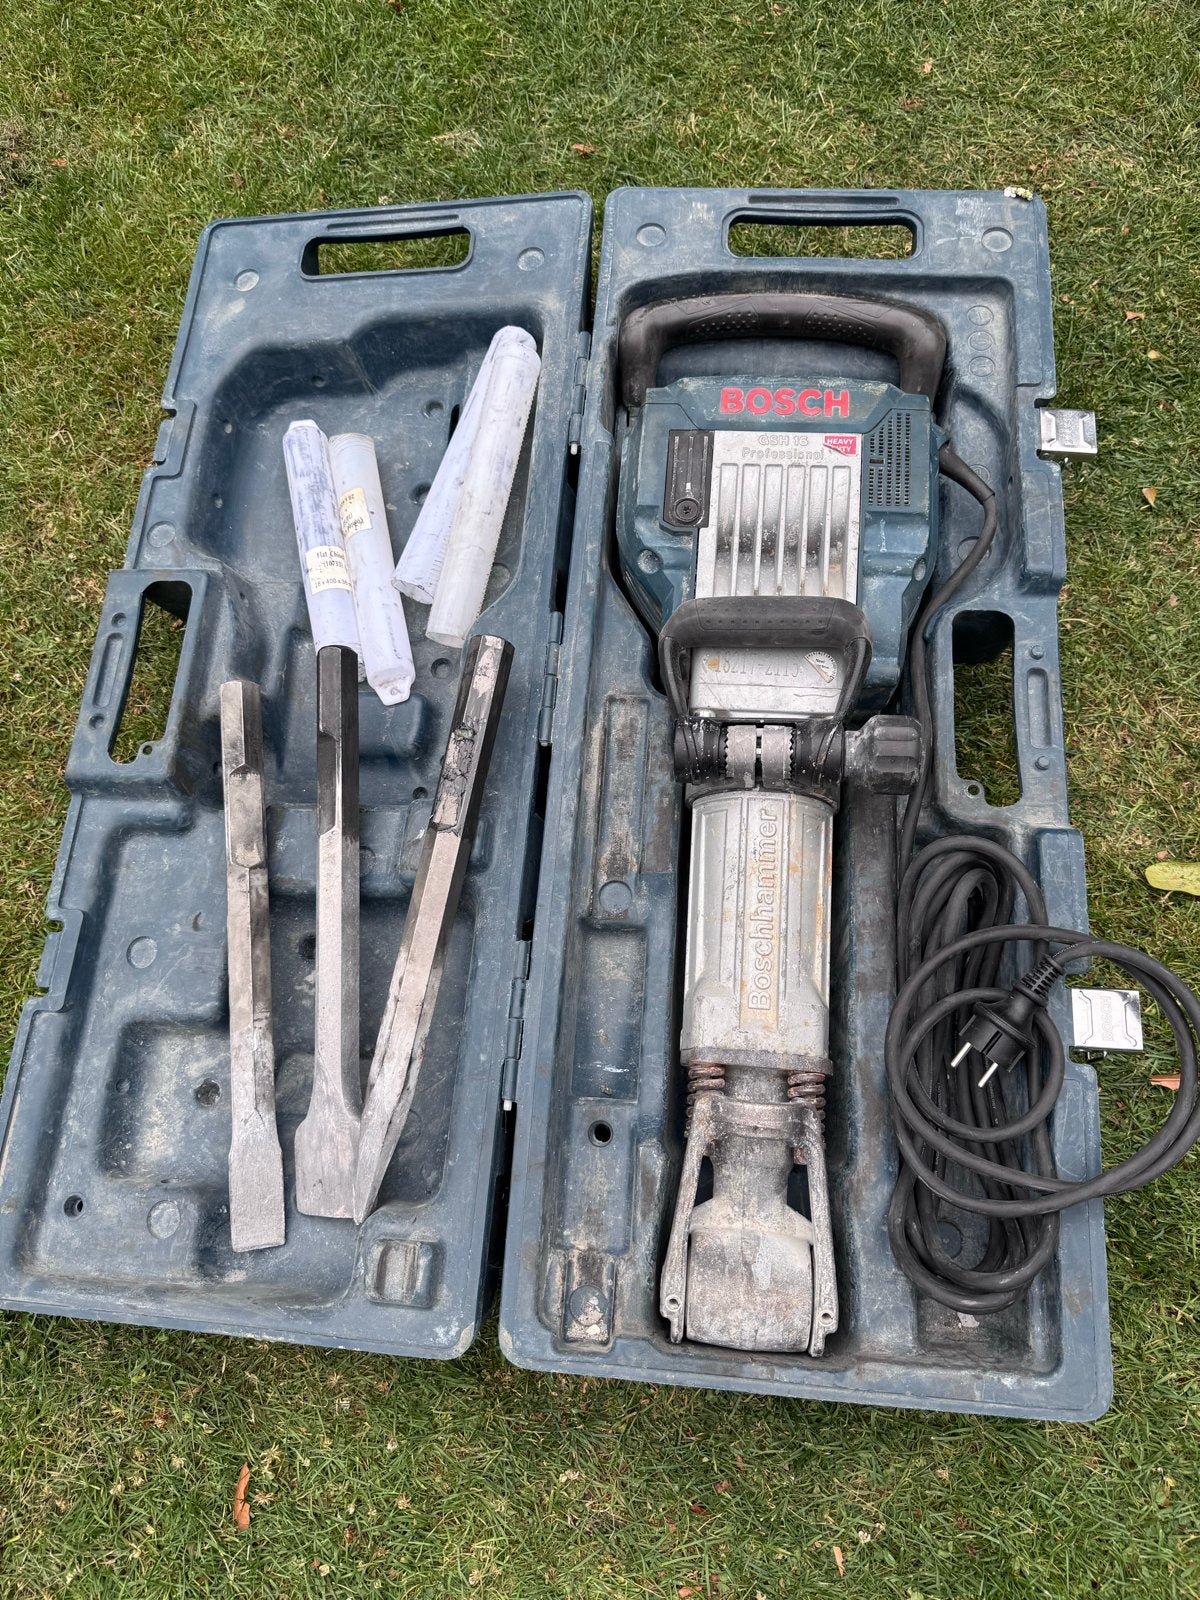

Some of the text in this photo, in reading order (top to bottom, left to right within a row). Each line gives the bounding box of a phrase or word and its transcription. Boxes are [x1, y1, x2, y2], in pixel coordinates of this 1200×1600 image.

[720, 387, 850, 417] BOSCH
[759, 434, 790, 446] GSH
[741, 447, 825, 461] Professional
[748, 808, 778, 1011] Boschhammer
